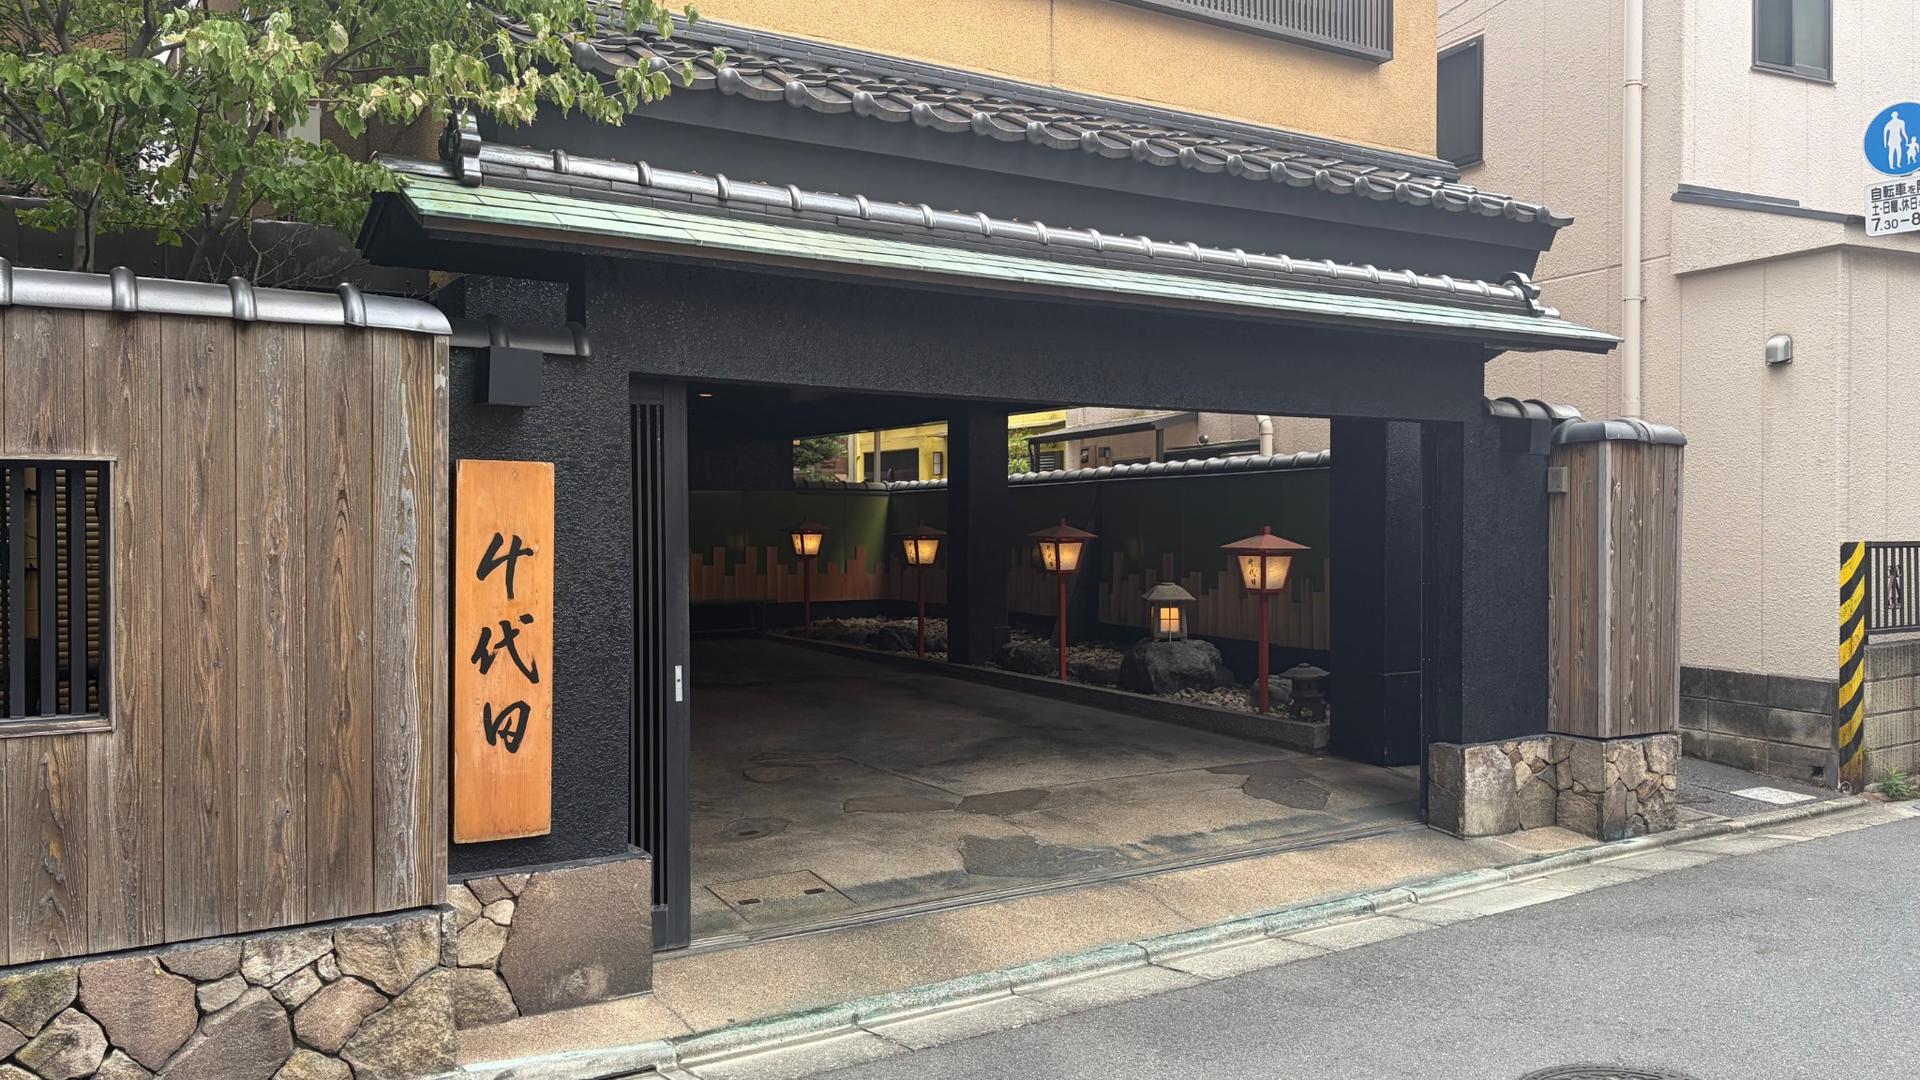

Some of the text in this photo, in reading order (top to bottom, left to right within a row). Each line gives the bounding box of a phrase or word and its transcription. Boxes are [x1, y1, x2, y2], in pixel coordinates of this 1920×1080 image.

[1871, 197, 1920, 216] 土・日曜、休日
[471, 532, 540, 754] 千代田
